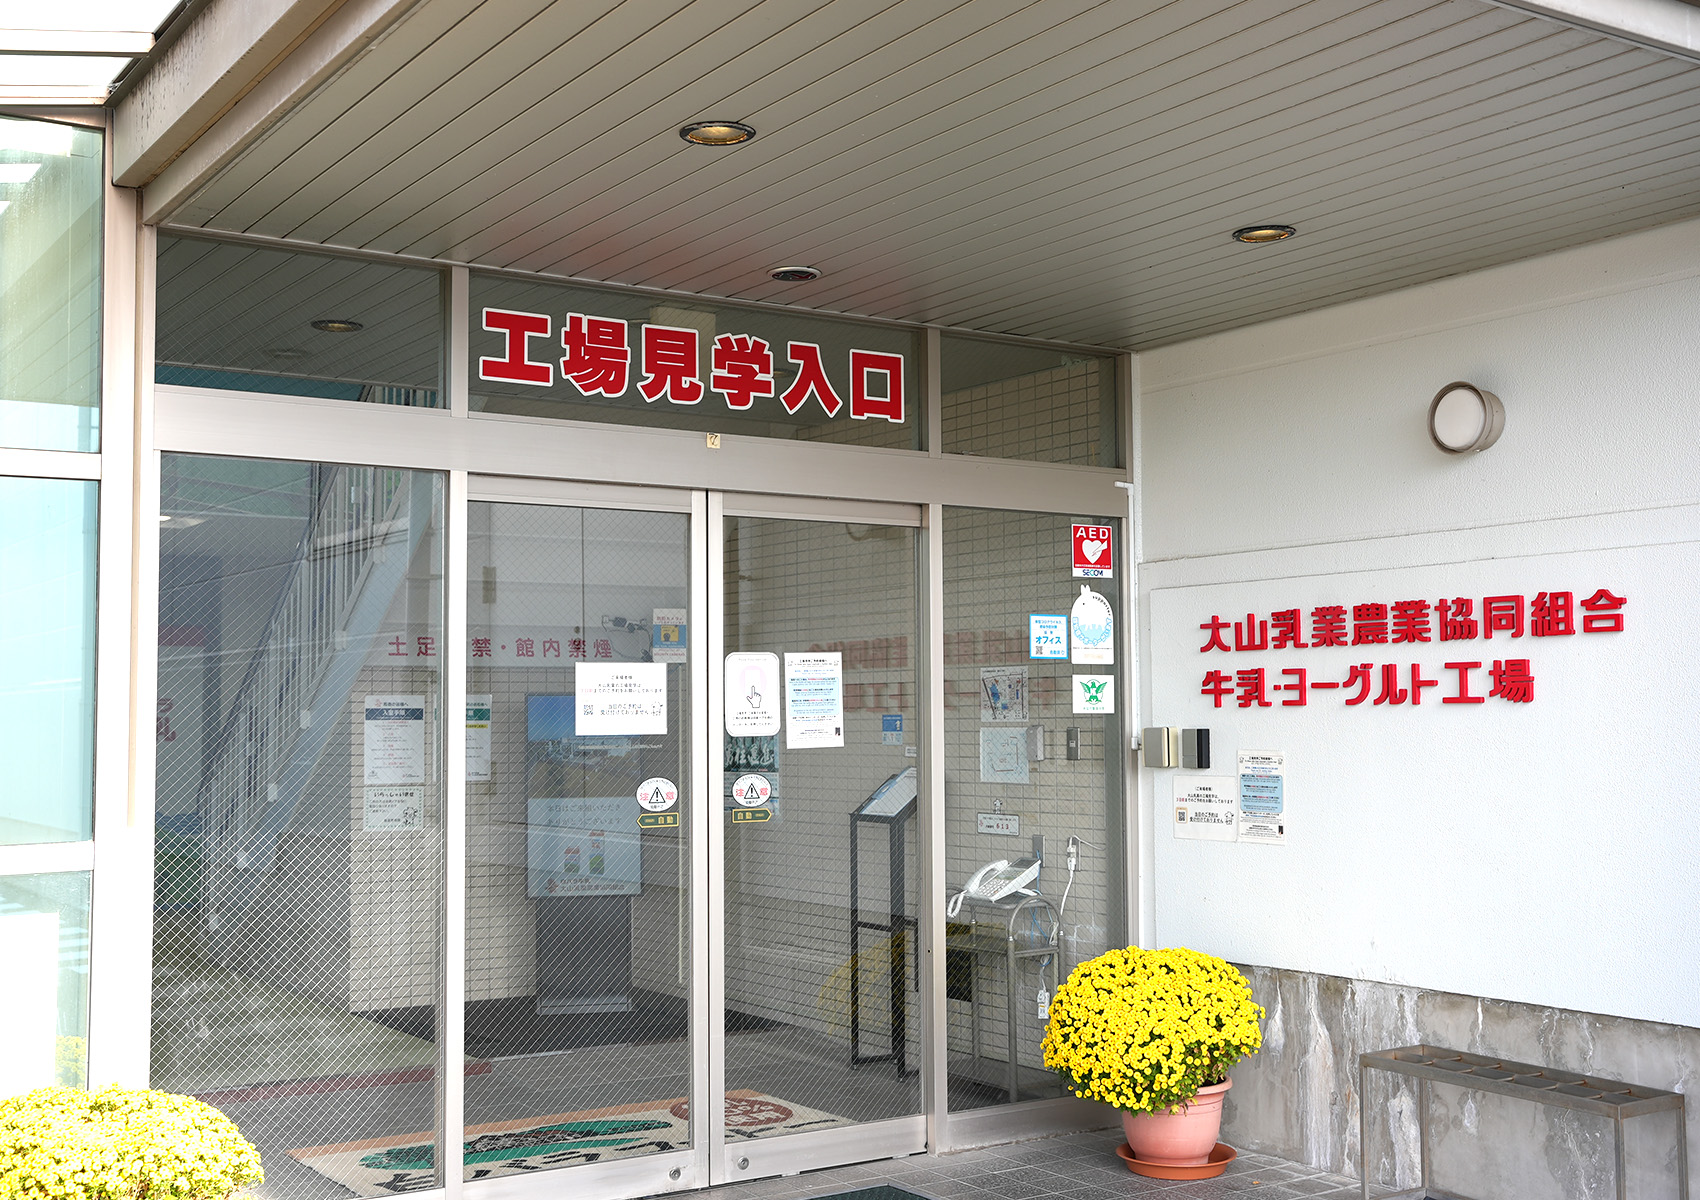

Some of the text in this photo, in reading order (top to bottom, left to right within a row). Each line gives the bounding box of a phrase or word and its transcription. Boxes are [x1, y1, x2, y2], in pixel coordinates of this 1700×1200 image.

[479, 307, 905, 423] 工場見学入口
[1076, 527, 1109, 539] AED
[1082, 568, 1104, 577] SECOM
[1199, 588, 1627, 653] 大山乳業農業協同組合
[1035, 635, 1062, 645] オフィス
[388, 636, 613, 658] 土足禁・館内禁煙
[1201, 659, 1535, 708] 牛乳・ヨーグルト工場
[640, 792, 650, 802] 注
[735, 788, 745, 798] 注
